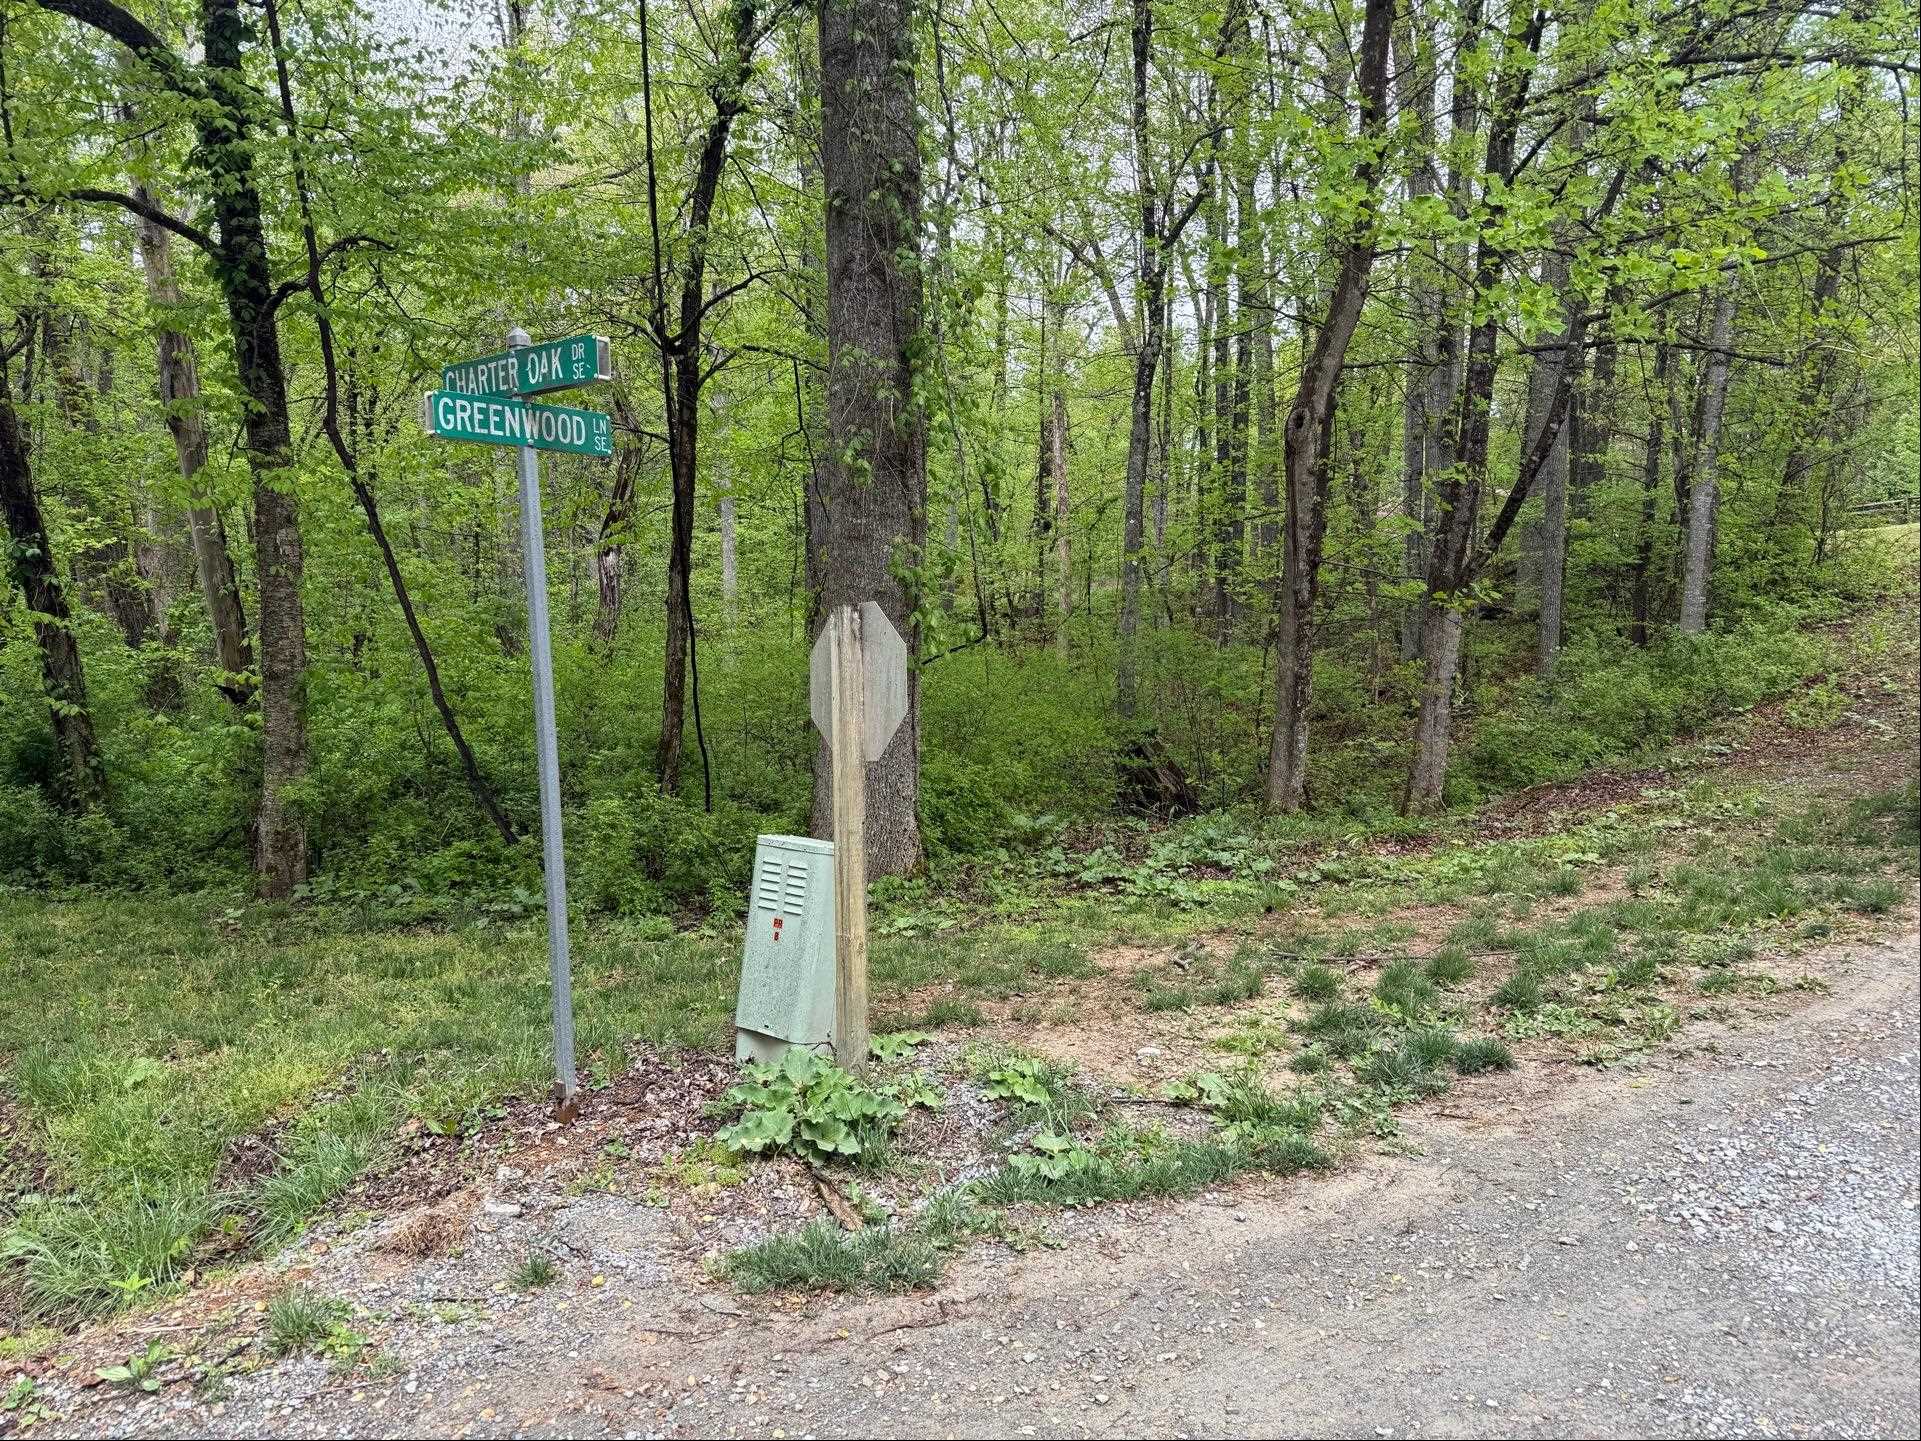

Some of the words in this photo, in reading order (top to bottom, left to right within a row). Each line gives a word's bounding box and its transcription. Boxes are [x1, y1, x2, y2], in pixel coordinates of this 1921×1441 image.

[445, 357, 520, 395] CHARTER
[528, 347, 564, 384] OAK
[572, 343, 585, 361] DR
[572, 363, 586, 380] SE
[439, 397, 586, 446] GREENWOOD
[593, 418, 607, 435] LN
[595, 437, 608, 452] SE
